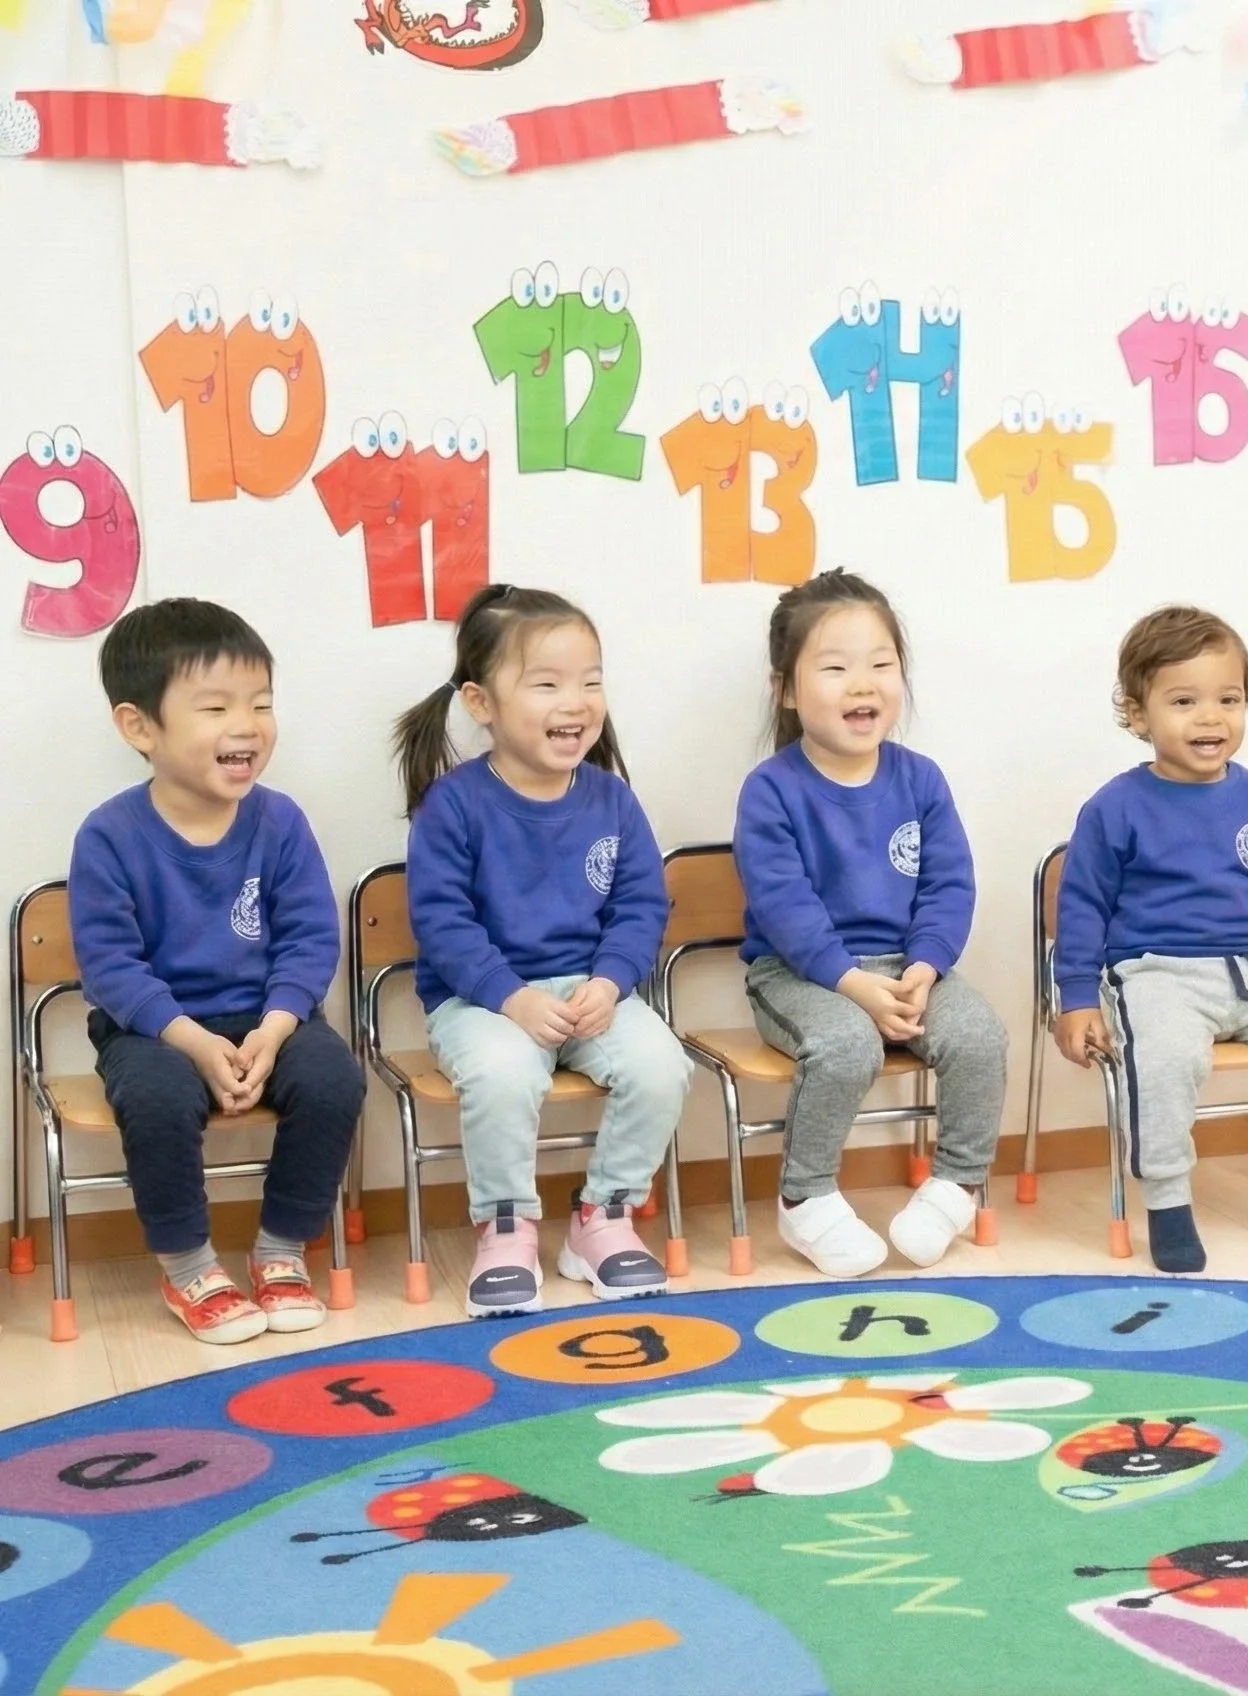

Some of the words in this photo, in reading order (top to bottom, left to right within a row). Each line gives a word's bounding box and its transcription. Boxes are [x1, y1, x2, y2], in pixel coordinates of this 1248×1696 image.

[139, 315, 326, 502] 10
[474, 288, 645, 481] 12
[811, 299, 961, 486] 14
[0, 448, 140, 637] 9
[312, 440, 491, 627] 11
[660, 403, 816, 585] 13
[965, 417, 1117, 582] 15
[58, 1452, 208, 1490] e
[325, 1378, 396, 1417] f
[559, 1325, 669, 1370] g
[1111, 1302, 1170, 1334] i
